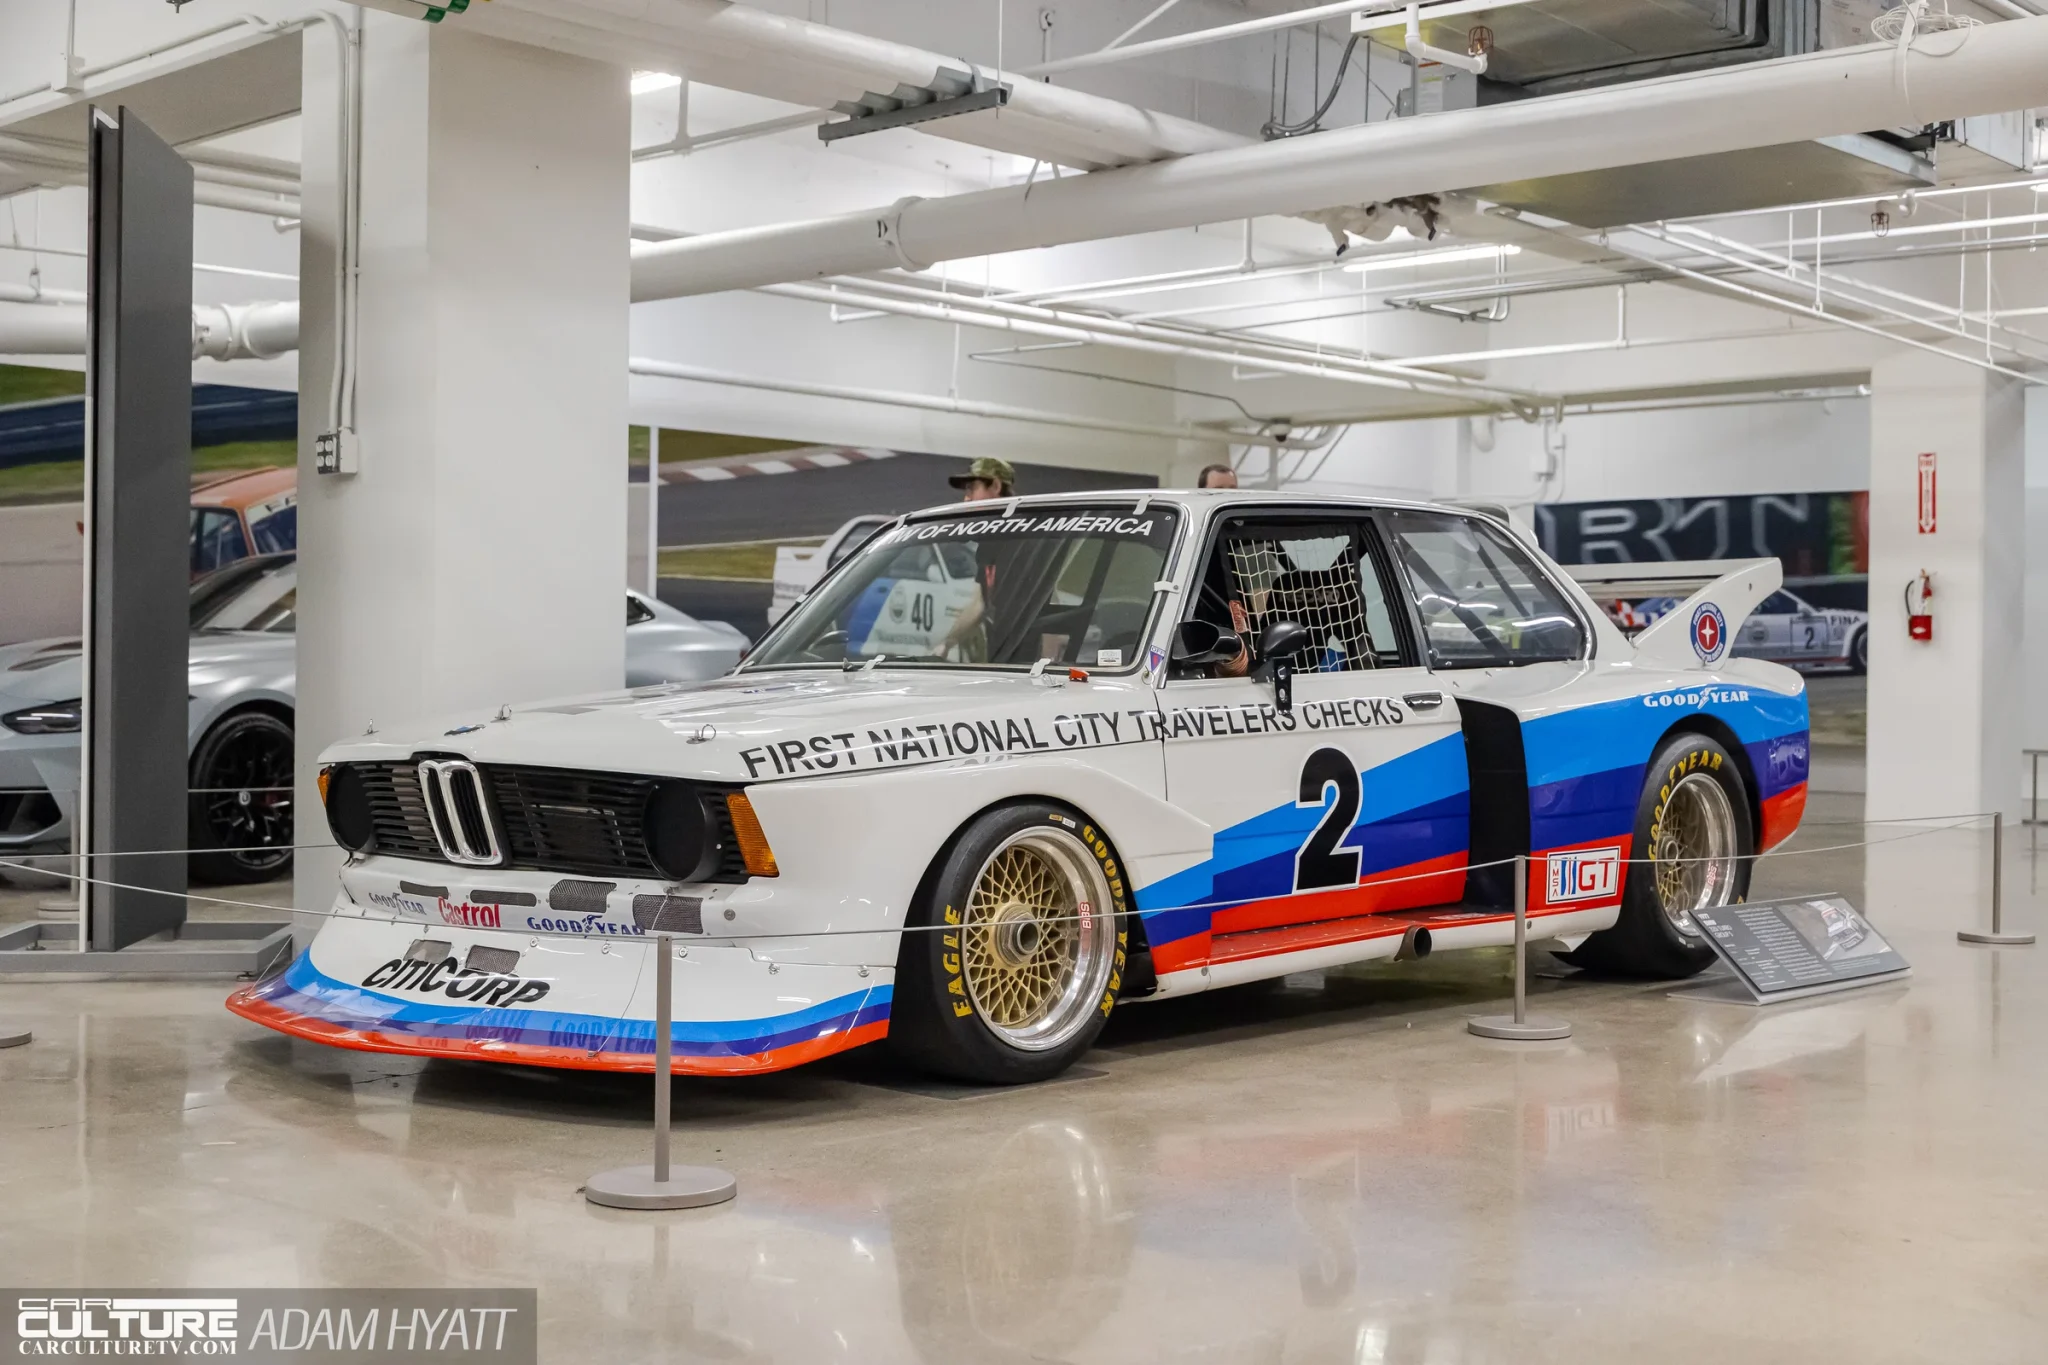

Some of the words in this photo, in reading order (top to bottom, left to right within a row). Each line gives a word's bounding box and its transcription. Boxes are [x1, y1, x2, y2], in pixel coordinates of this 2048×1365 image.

[917, 524, 953, 541] OF
[950, 517, 1031, 537] NORTH
[1032, 516, 1154, 537] AMERICA
[911, 592, 933, 632] 40
[1804, 626, 1815, 650] 2
[738, 732, 857, 778] FIRST
[867, 718, 1050, 763] NATIONAL
[1054, 711, 1121, 746] CITY
[1128, 704, 1297, 739] TRAVELERS
[1303, 697, 1404, 730] CHECKS
[1296, 746, 1361, 891] 2
[1578, 857, 1615, 892] GT
[437, 896, 502, 928] Castrol
[1079, 901, 1092, 930] BBS
[943, 904, 973, 1018] EAGLE
[361, 956, 551, 1008] CITICORP
